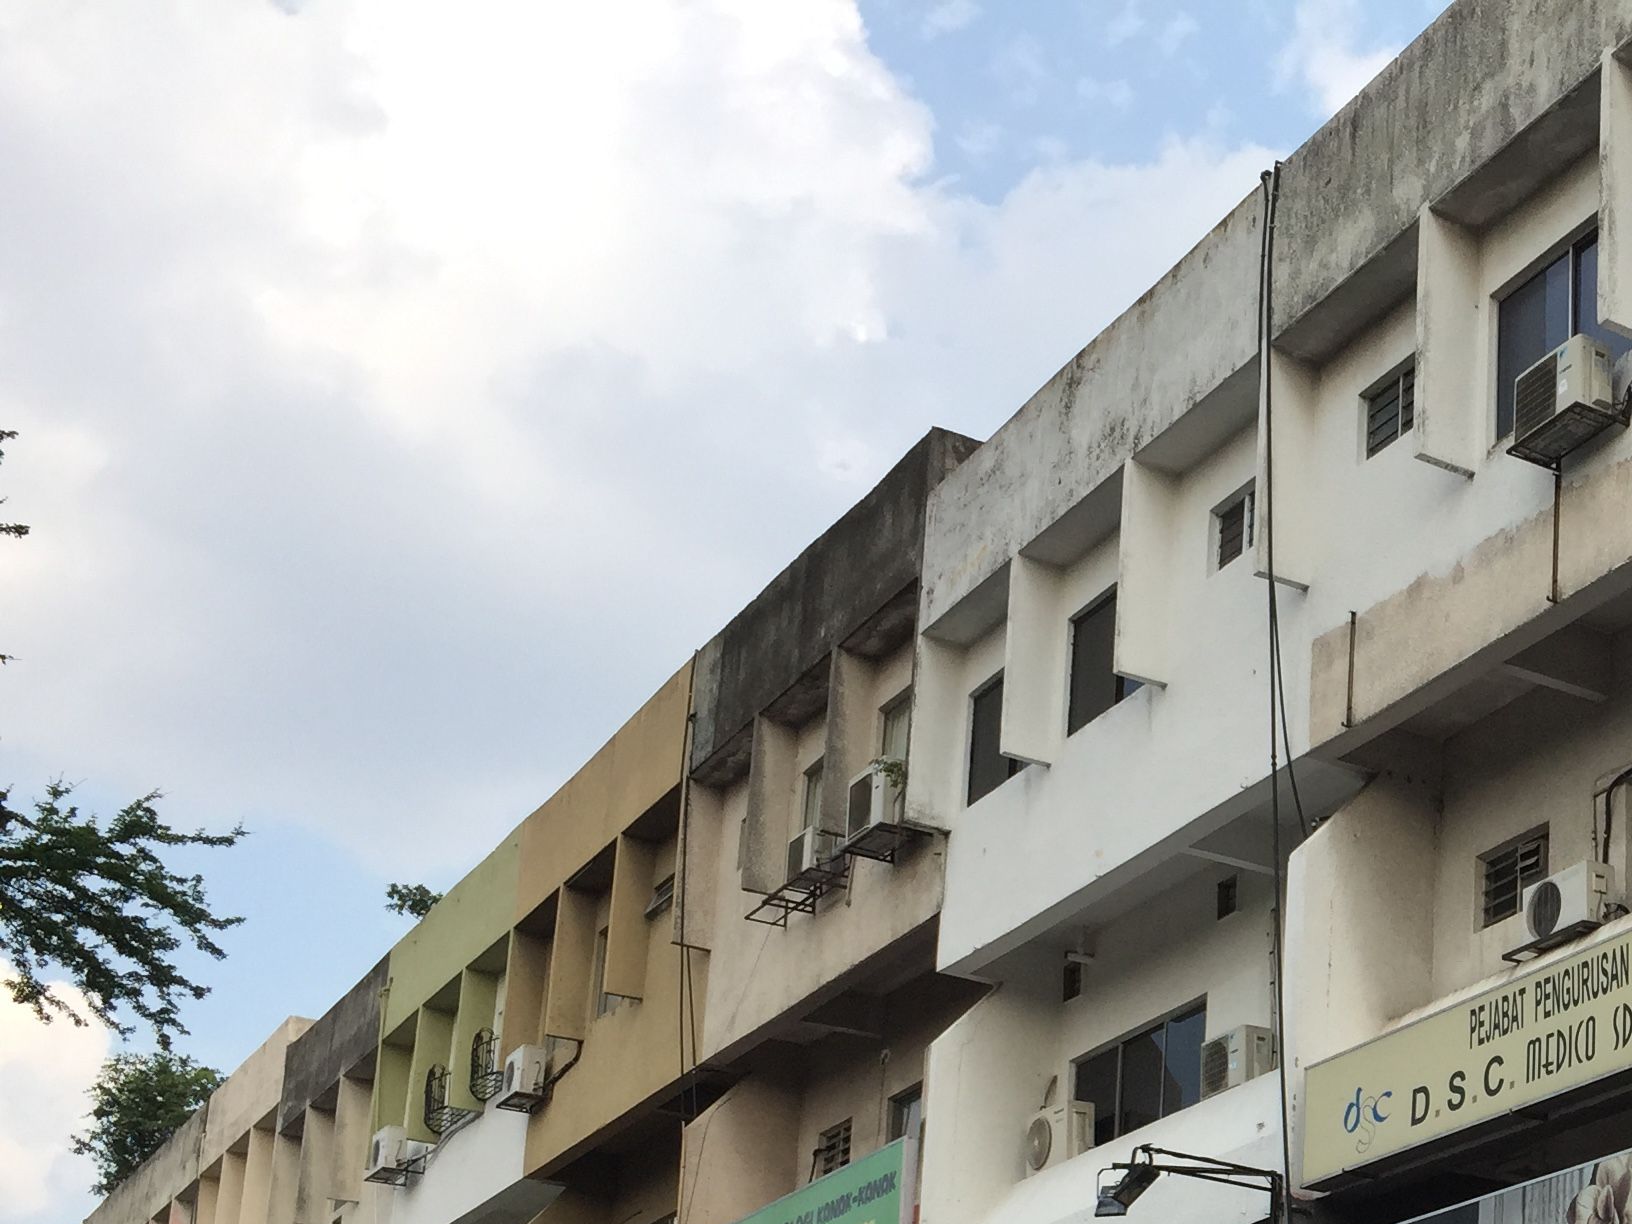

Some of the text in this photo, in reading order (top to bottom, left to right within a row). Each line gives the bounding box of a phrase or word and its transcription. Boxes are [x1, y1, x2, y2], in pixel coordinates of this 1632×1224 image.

[1469, 943, 1630, 1049] PEJABAT PENGURUSAN
[1525, 1015, 1597, 1084] MEDICO
